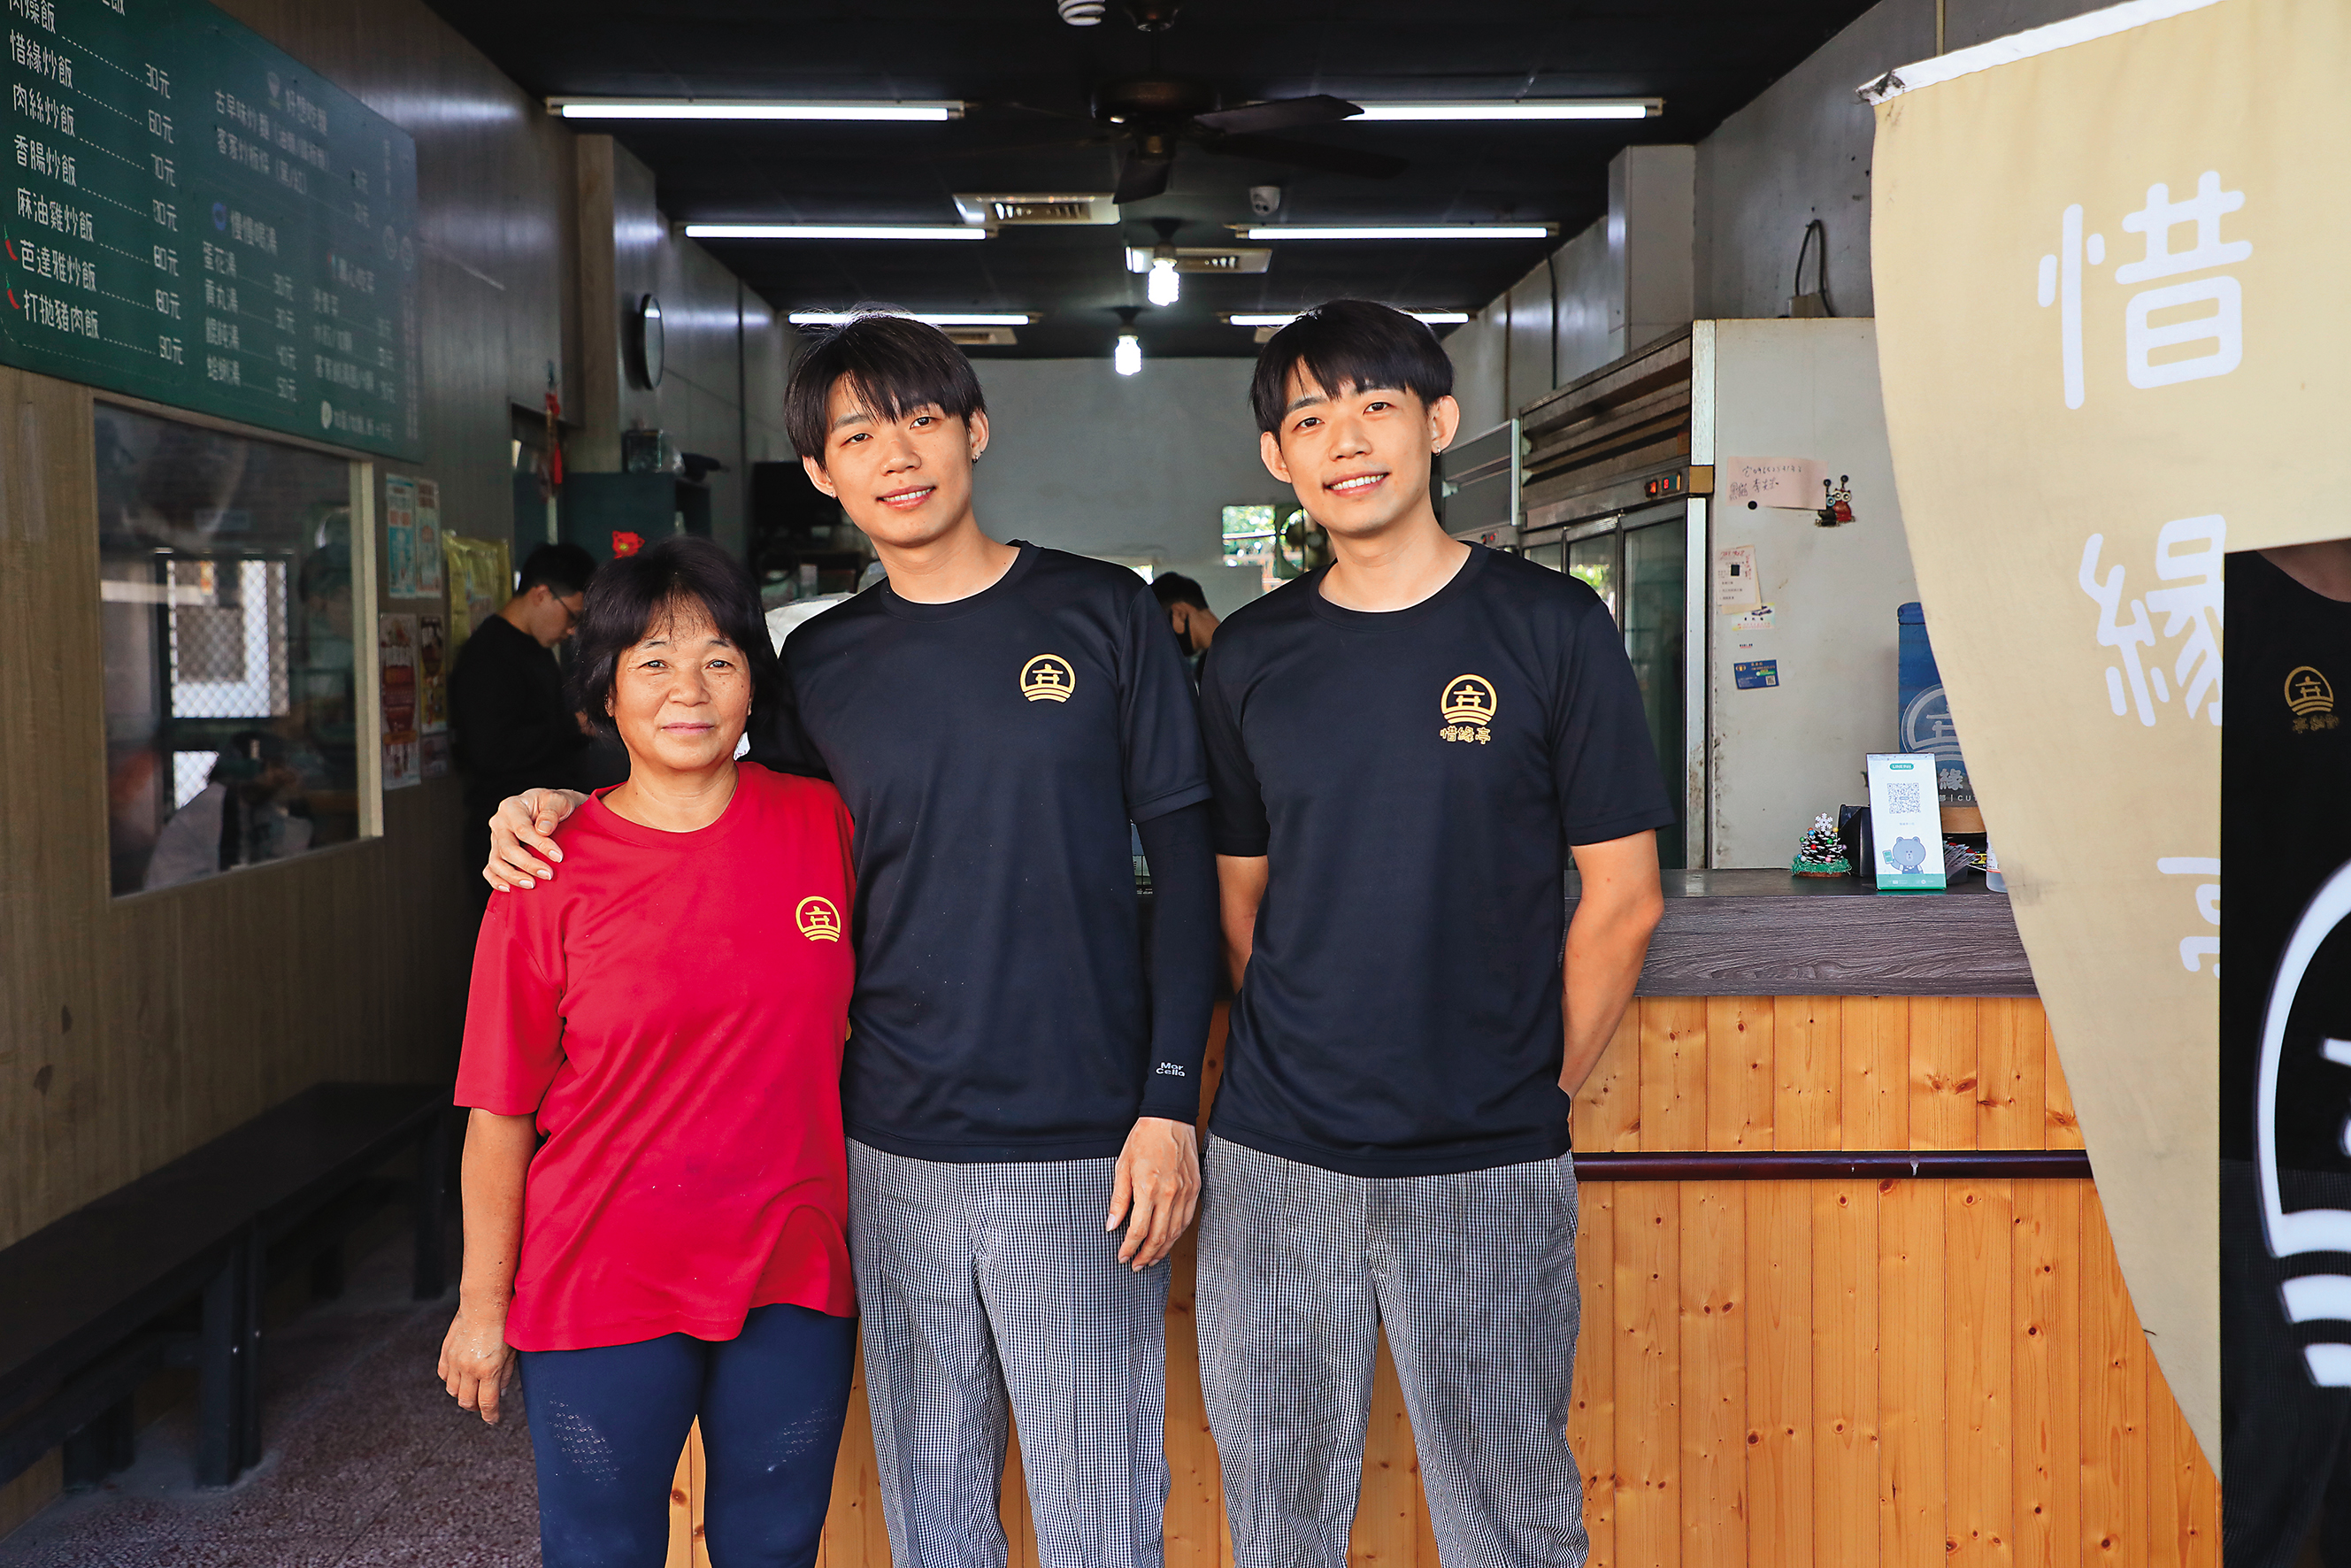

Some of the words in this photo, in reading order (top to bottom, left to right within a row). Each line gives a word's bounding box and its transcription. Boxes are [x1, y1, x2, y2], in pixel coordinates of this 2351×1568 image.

[10, 28, 73, 89] 惜緣炒飯
[149, 109, 174, 144] 60元
[145, 63, 172, 100] 30元
[12, 82, 76, 137] 肉絲炒飯
[150, 153, 176, 188] 70元
[13, 134, 77, 188] 香腸炒飯
[17, 187, 95, 243] 麻油雞炒飯
[19, 239, 97, 292] 芭達雅炒飯
[1440, 725, 1491, 745] 惜緣亭
[1160, 1062, 1184, 1071] Mar
